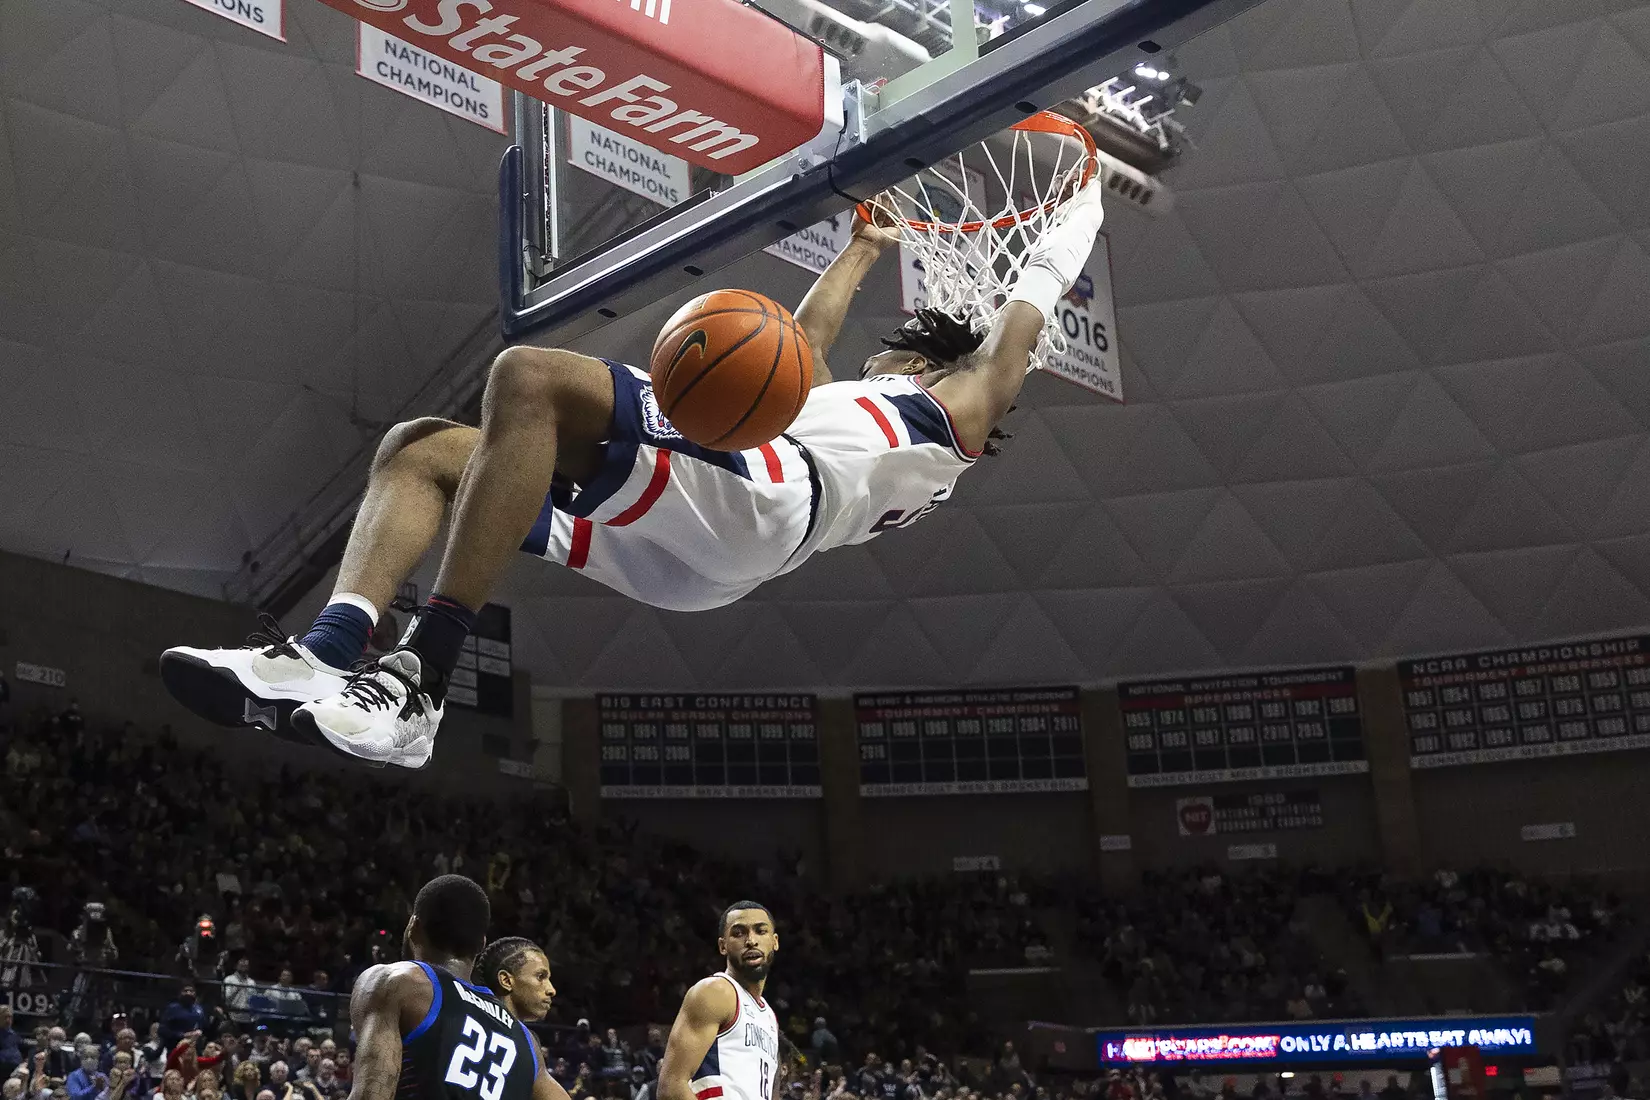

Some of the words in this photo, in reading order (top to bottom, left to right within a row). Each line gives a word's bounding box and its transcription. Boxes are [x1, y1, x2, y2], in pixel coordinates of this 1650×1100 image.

[384, 39, 481, 93] NATIONAL
[376, 61, 489, 119] CHAMPIONS
[590, 130, 671, 179] NATIONAL
[584, 151, 679, 203] CHAMPIONS
[1046, 355, 1115, 393] CHAMPIONS
[1412, 659, 1467, 675] NCAA
[1478, 640, 1639, 669] CHAMPIONSHIP
[640, 697, 684, 708] EAST
[695, 697, 812, 708] CONFERENCE
[732, 711, 812, 720] CHAMPIONS
[876, 707, 969, 718] TOURNAMENT
[976, 704, 1059, 715] CHAMPIONS
[5, 991, 48, 1013] 109
[445, 1014, 517, 1100] 23
[1280, 1034, 1332, 1053] ONLY
